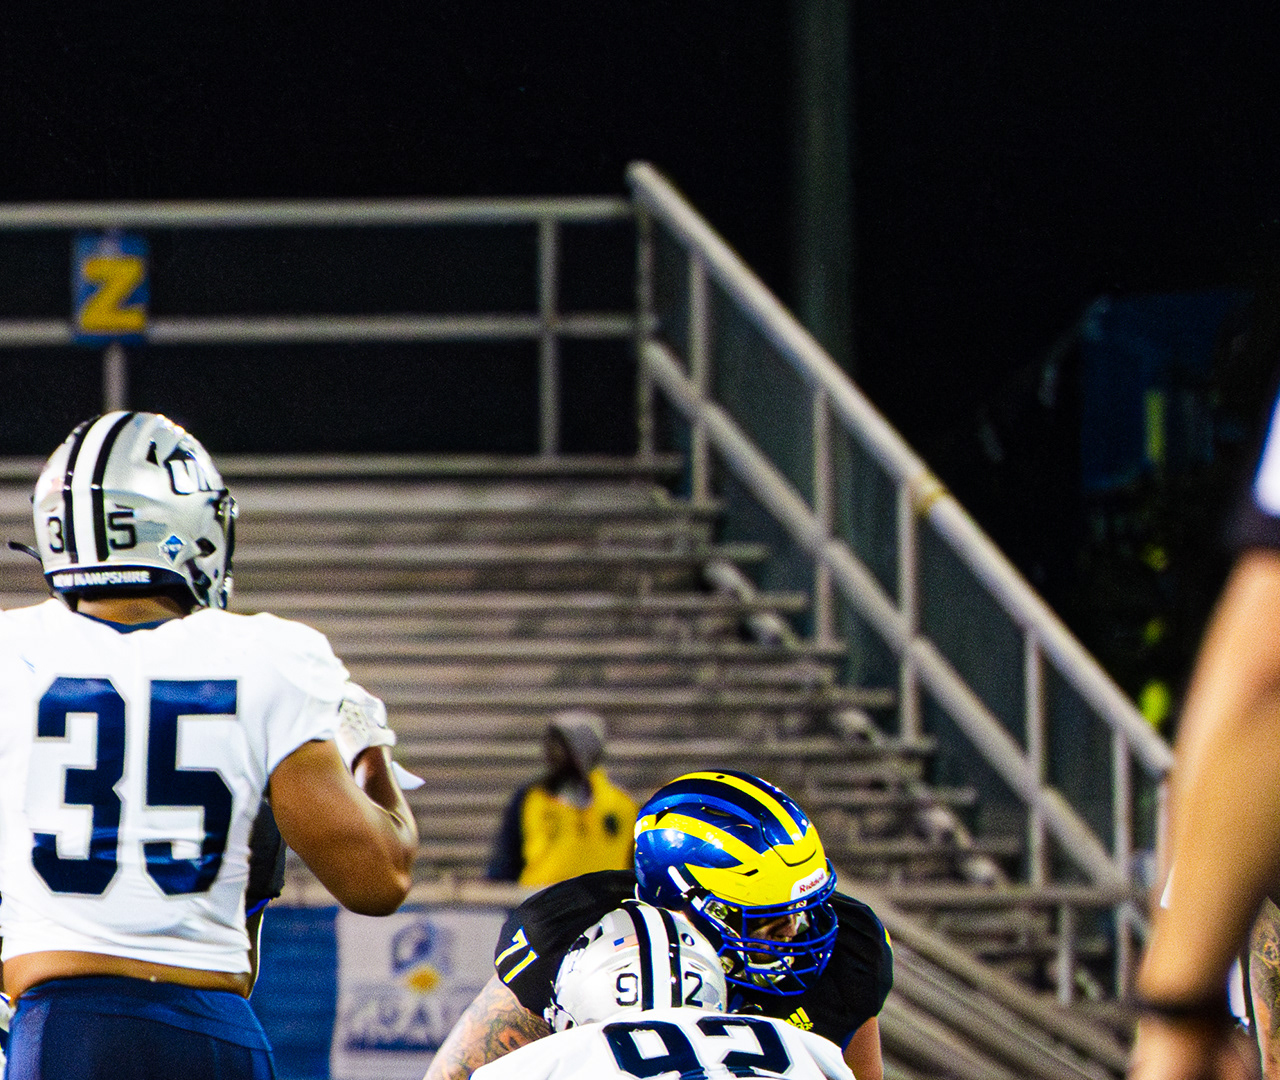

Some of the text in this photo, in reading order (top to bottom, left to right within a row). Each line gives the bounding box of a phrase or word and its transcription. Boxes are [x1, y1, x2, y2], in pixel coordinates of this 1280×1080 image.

[80, 255, 147, 332] Z
[30, 675, 239, 897] 35
[494, 927, 540, 985] 71
[601, 1015, 794, 1080] 92
